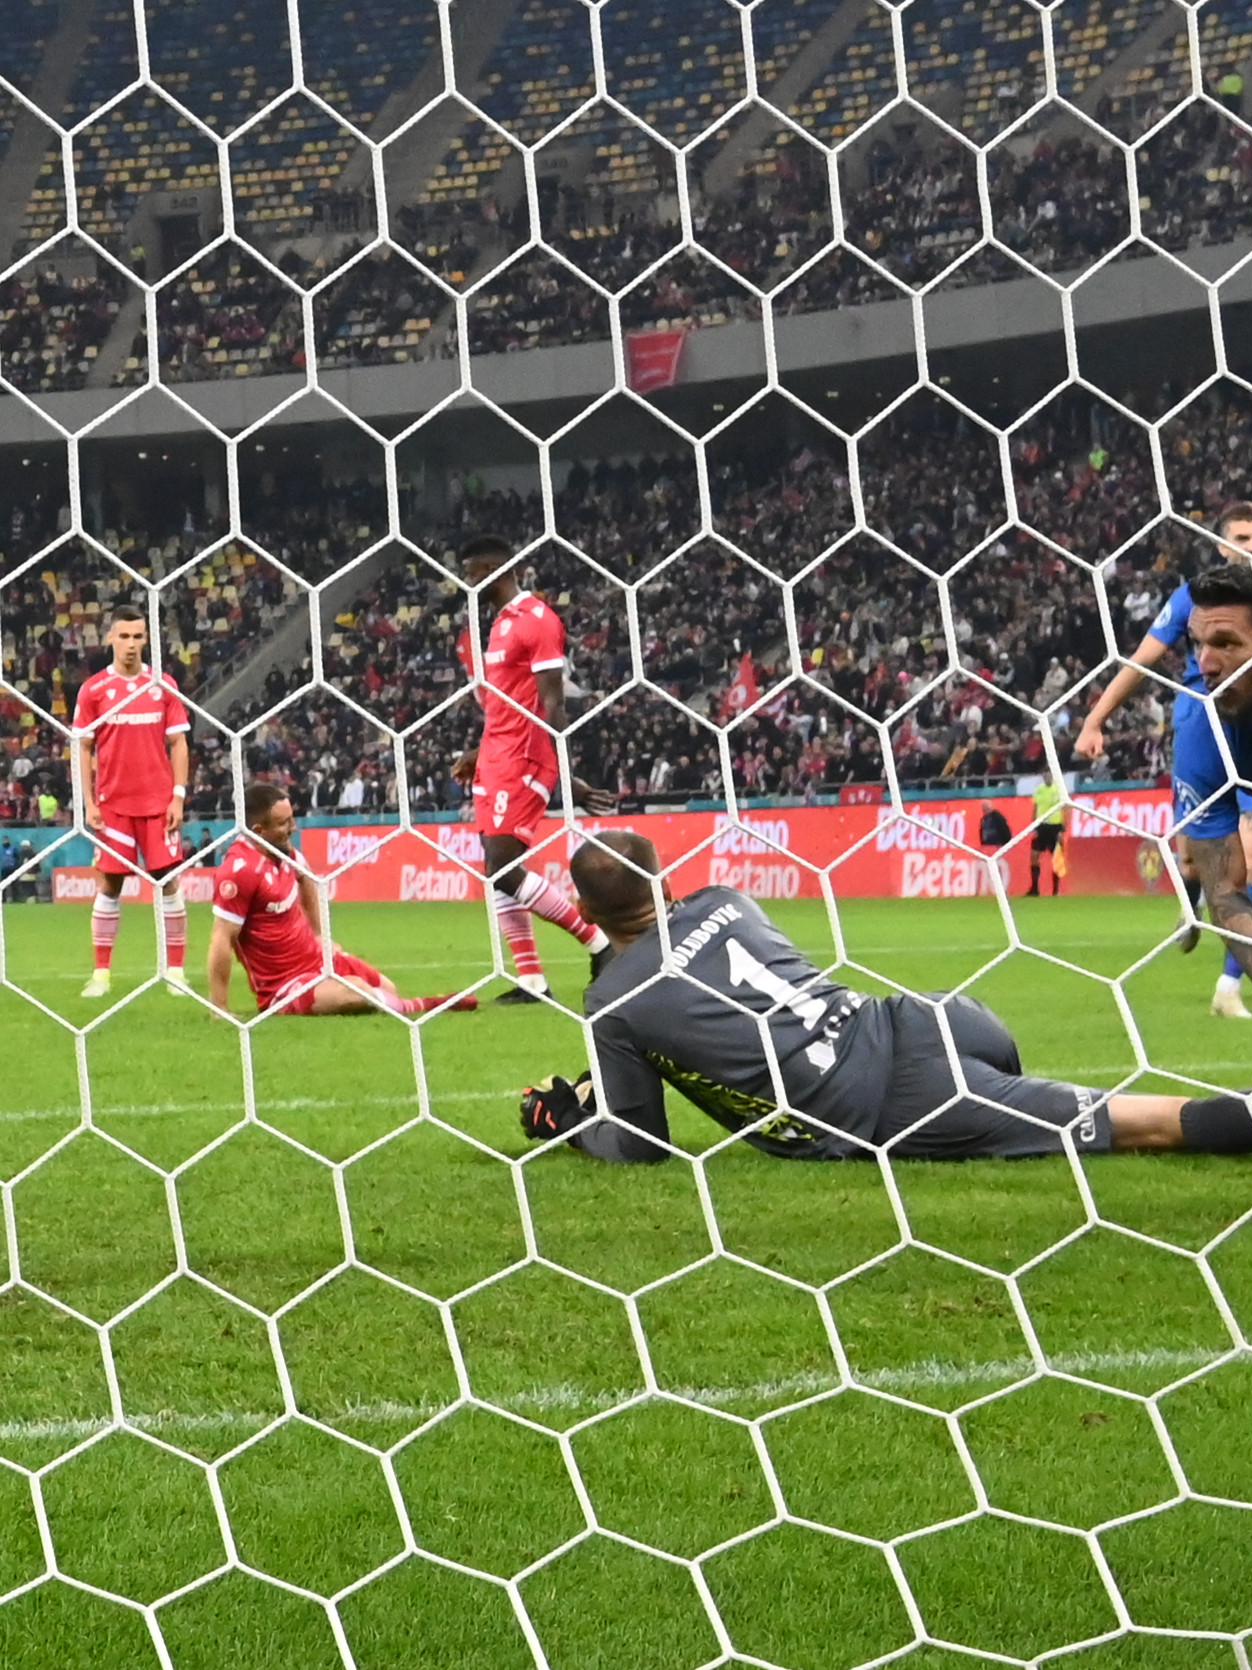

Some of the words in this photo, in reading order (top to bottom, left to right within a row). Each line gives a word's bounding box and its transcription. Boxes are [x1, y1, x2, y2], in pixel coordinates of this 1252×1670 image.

[494, 791, 508, 814] 8
[1071, 797, 1174, 838] Betano
[327, 830, 380, 865] Betano
[714, 815, 789, 855] Betano
[876, 805, 966, 851] Betano
[402, 865, 469, 900] Betano
[709, 858, 800, 899] Betano
[901, 853, 1010, 897] Betano
[725, 937, 828, 1031] 1
